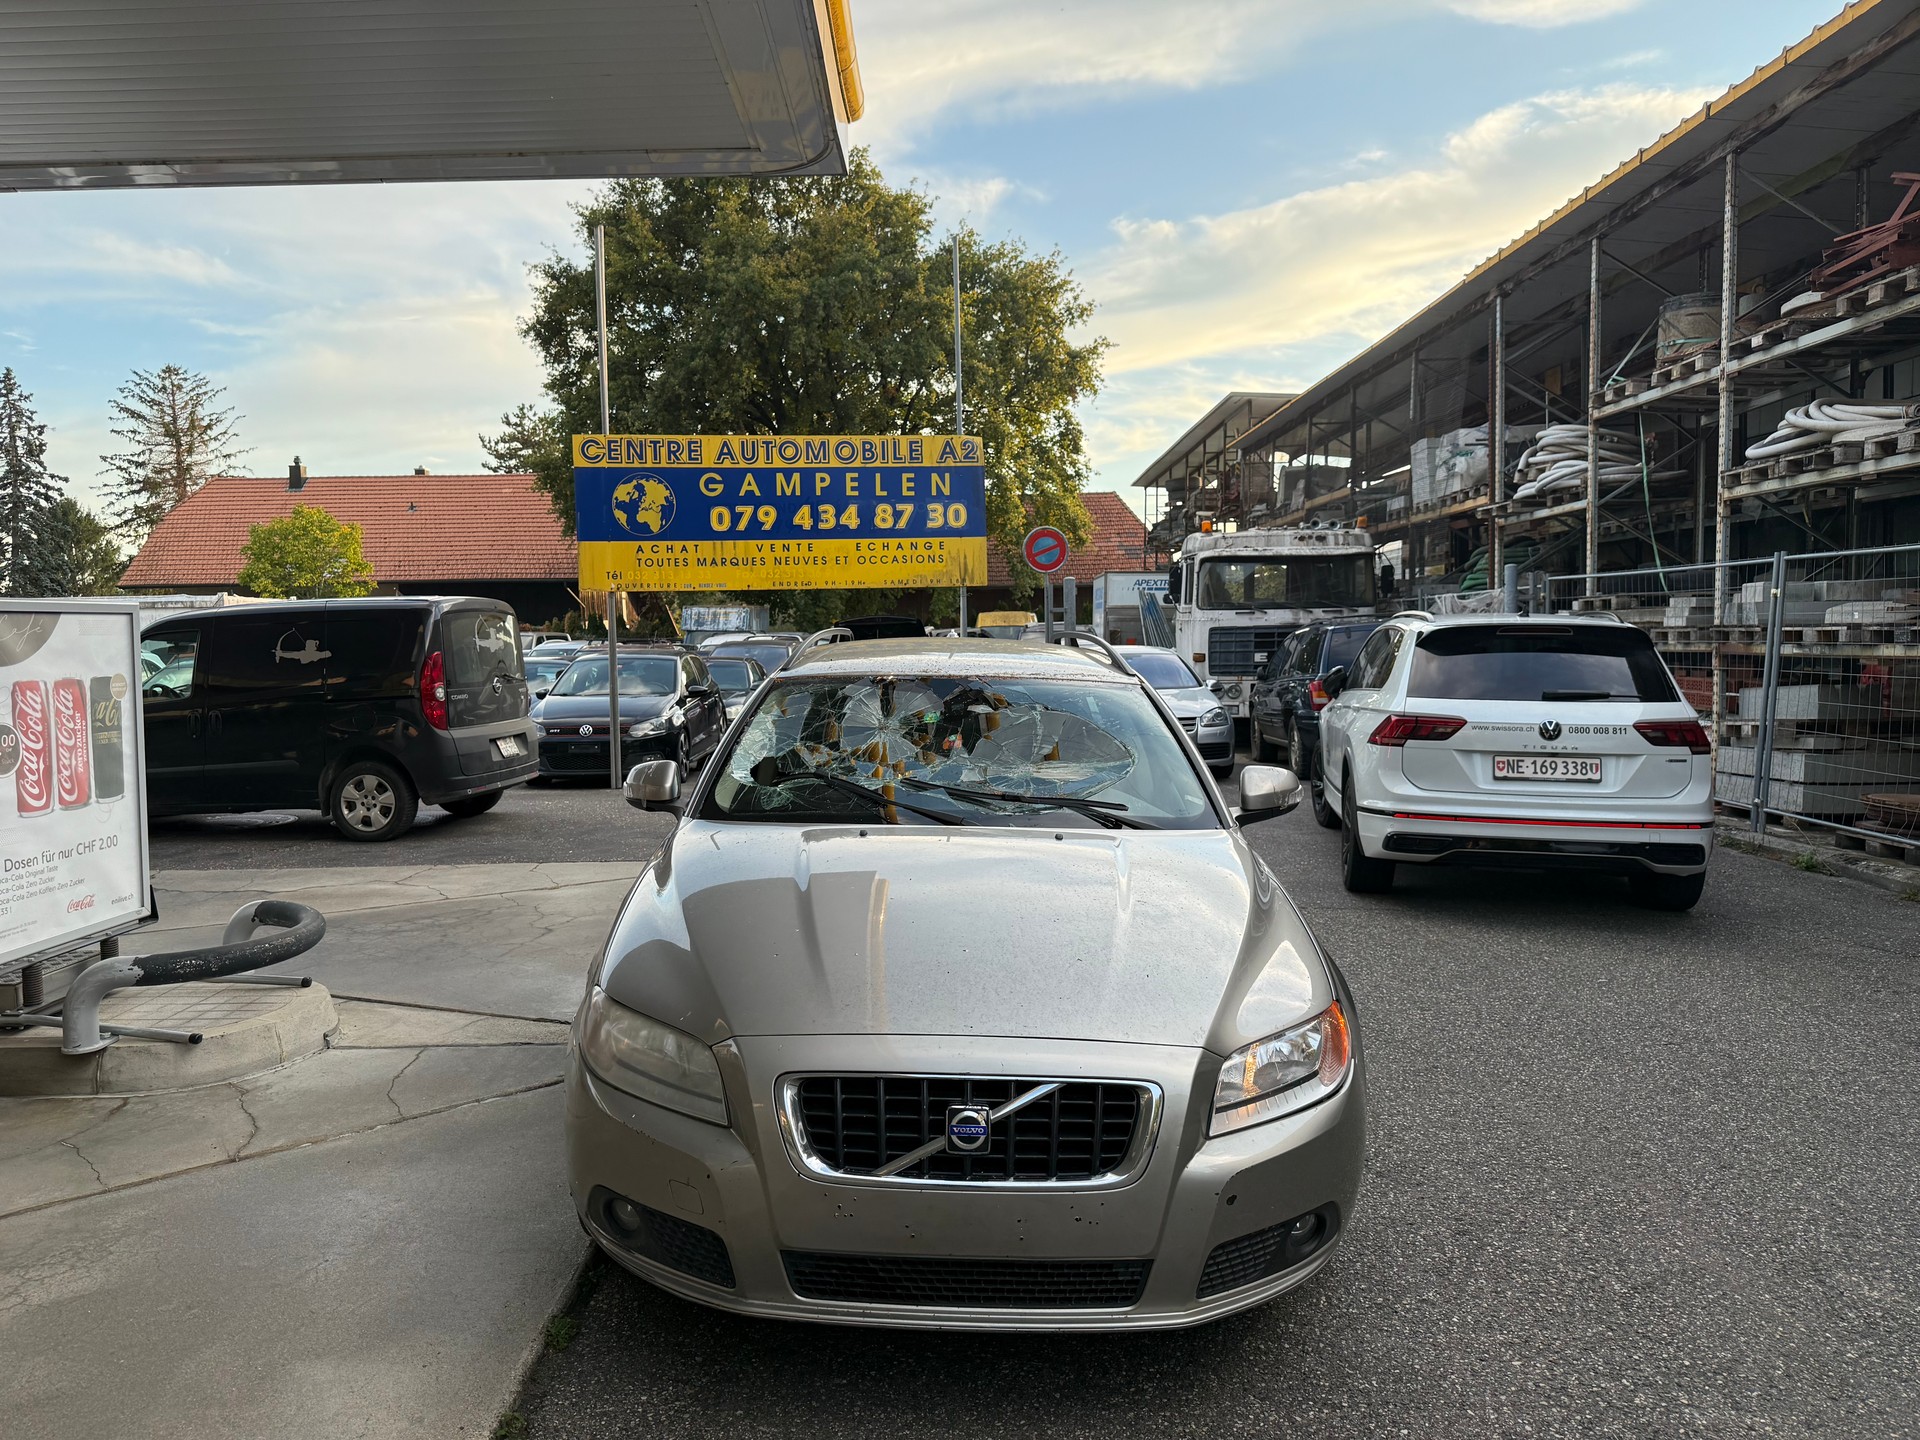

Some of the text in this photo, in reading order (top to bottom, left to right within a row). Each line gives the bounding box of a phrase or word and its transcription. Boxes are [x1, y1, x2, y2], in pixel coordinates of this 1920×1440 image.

[579, 438, 979, 465] CENTRE AUTOMOBILE A2
[699, 472, 950, 497] GAMPELEN
[709, 502, 968, 532] 079 434 87 30
[636, 541, 945, 554] ACHAT VENTE ECHANGE
[636, 554, 945, 567] TOUTES MARQUES NEUVES ET OCCASIONS
[605, 570, 623, 580] Tél
[627, 570, 648, 580] 032
[760, 569, 780, 578] 032
[1471, 725, 1628, 735] www.swissora.ch 0800 008 811
[4, 834, 118, 872] Dosen für nur CHF 2.00
